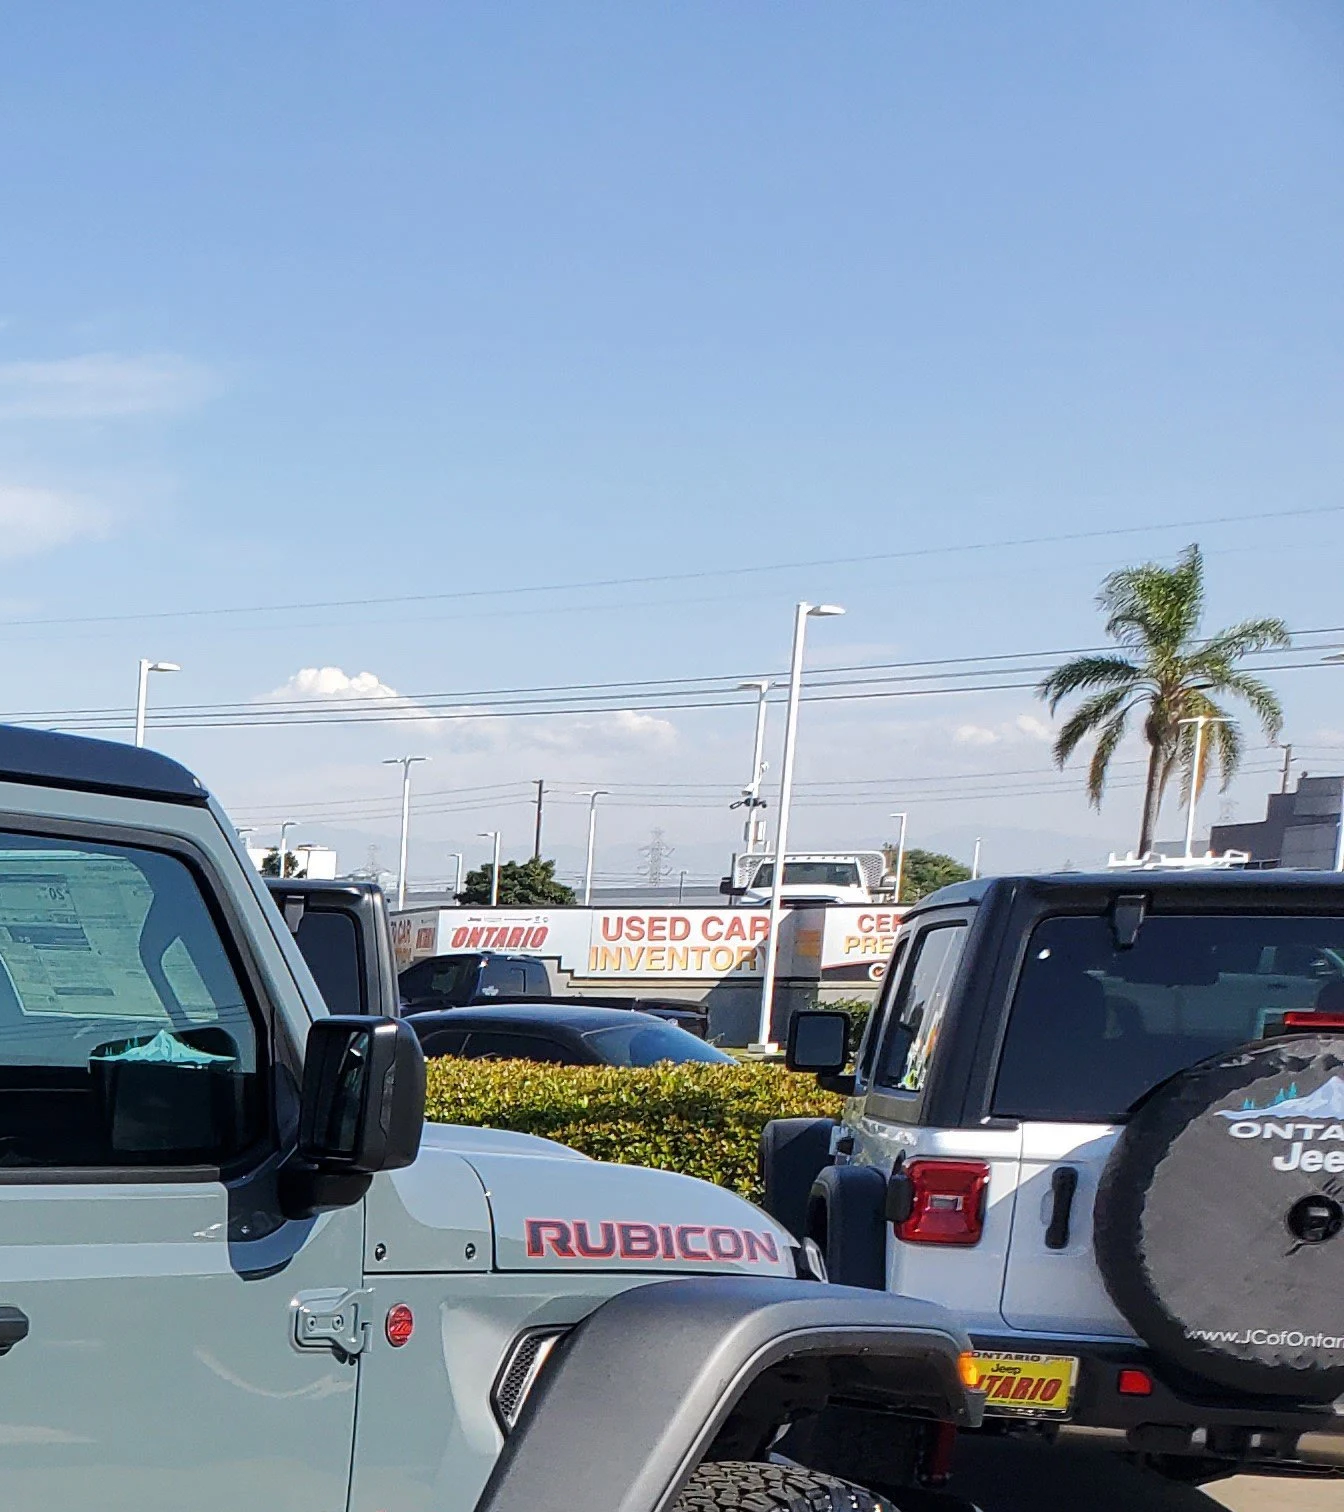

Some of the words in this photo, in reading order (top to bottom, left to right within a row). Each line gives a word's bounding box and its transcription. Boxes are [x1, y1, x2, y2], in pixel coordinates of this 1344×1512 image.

[450, 926, 549, 949] ONTARIO
[601, 916, 691, 942] USED
[701, 916, 770, 942] CAR
[1272, 1141, 1344, 1173] Jee
[524, 1217, 781, 1264] RUBICON
[990, 1363, 1022, 1376] Jeep
